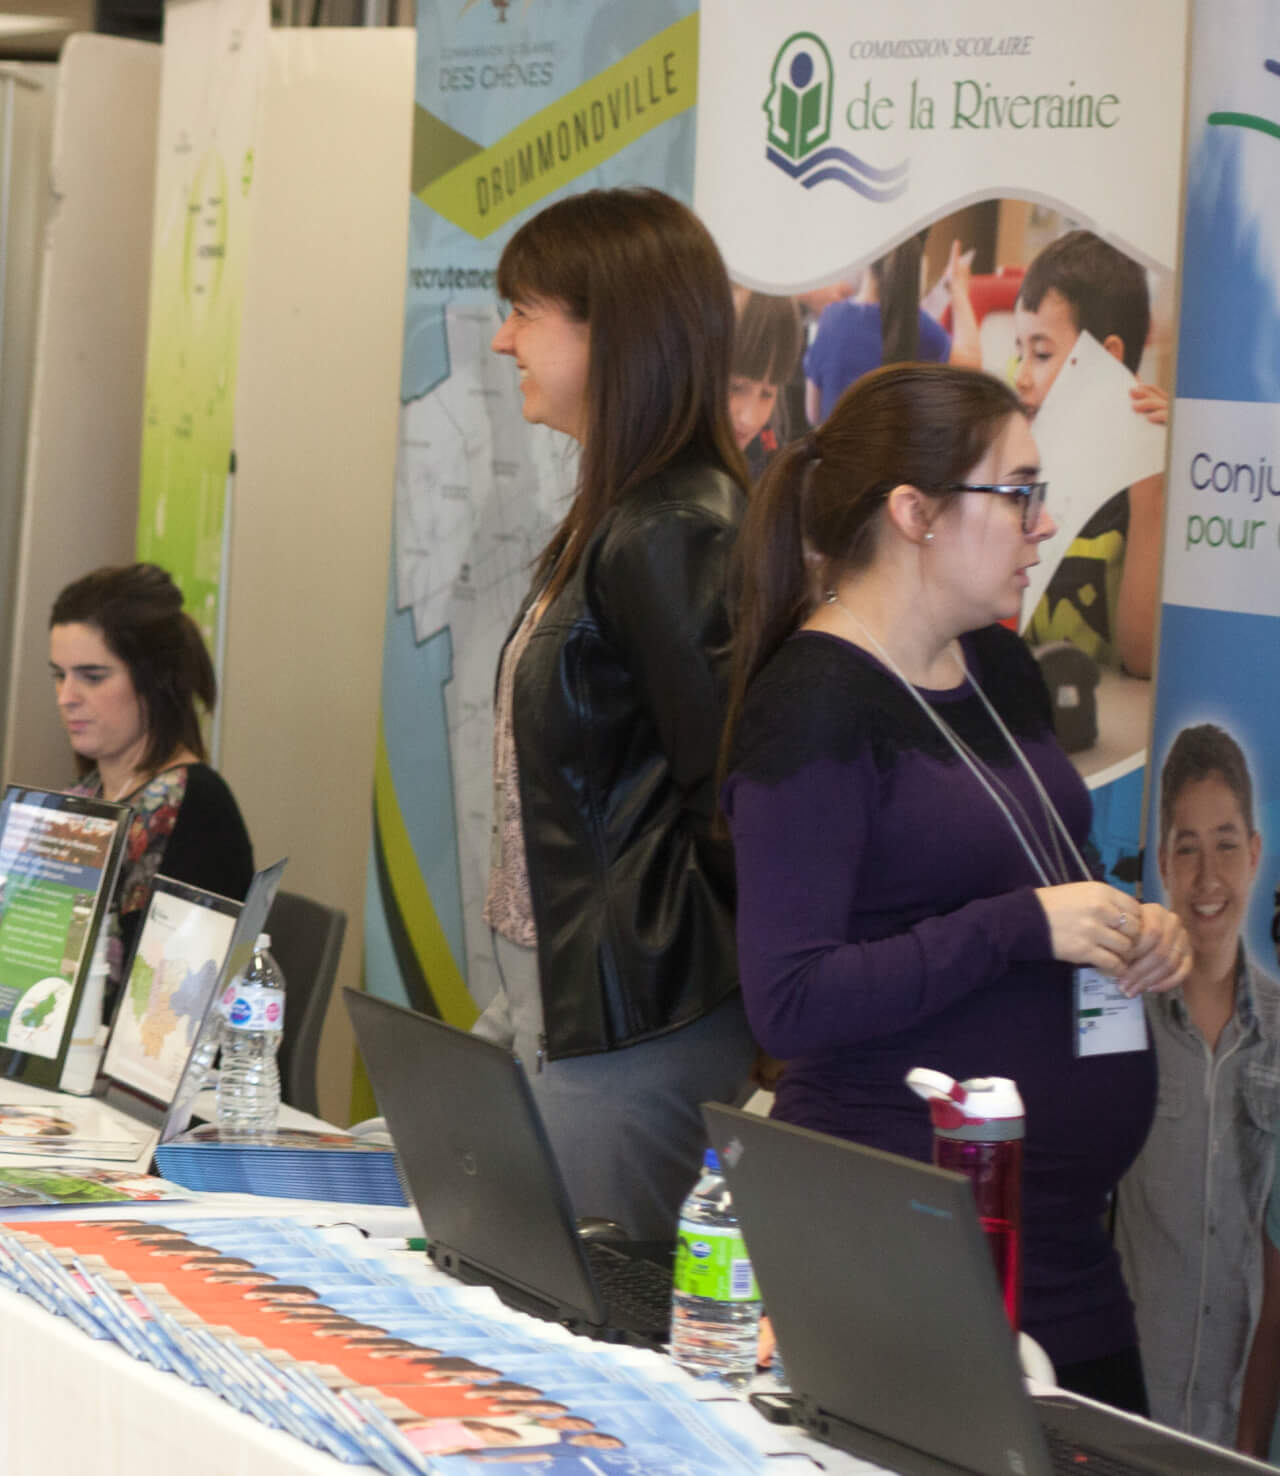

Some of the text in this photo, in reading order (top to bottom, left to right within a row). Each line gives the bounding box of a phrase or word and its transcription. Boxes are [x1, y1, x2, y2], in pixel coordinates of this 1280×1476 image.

[849, 36, 1034, 59] COMMISSION SCOLAIRE
[438, 55, 554, 92] DES CHÊNES
[846, 77, 1120, 130] de la Riveraine
[475, 52, 678, 216] DRUMMONDVILLE
[1190, 452, 1280, 503] Conju
[1185, 514, 1266, 551] pour
